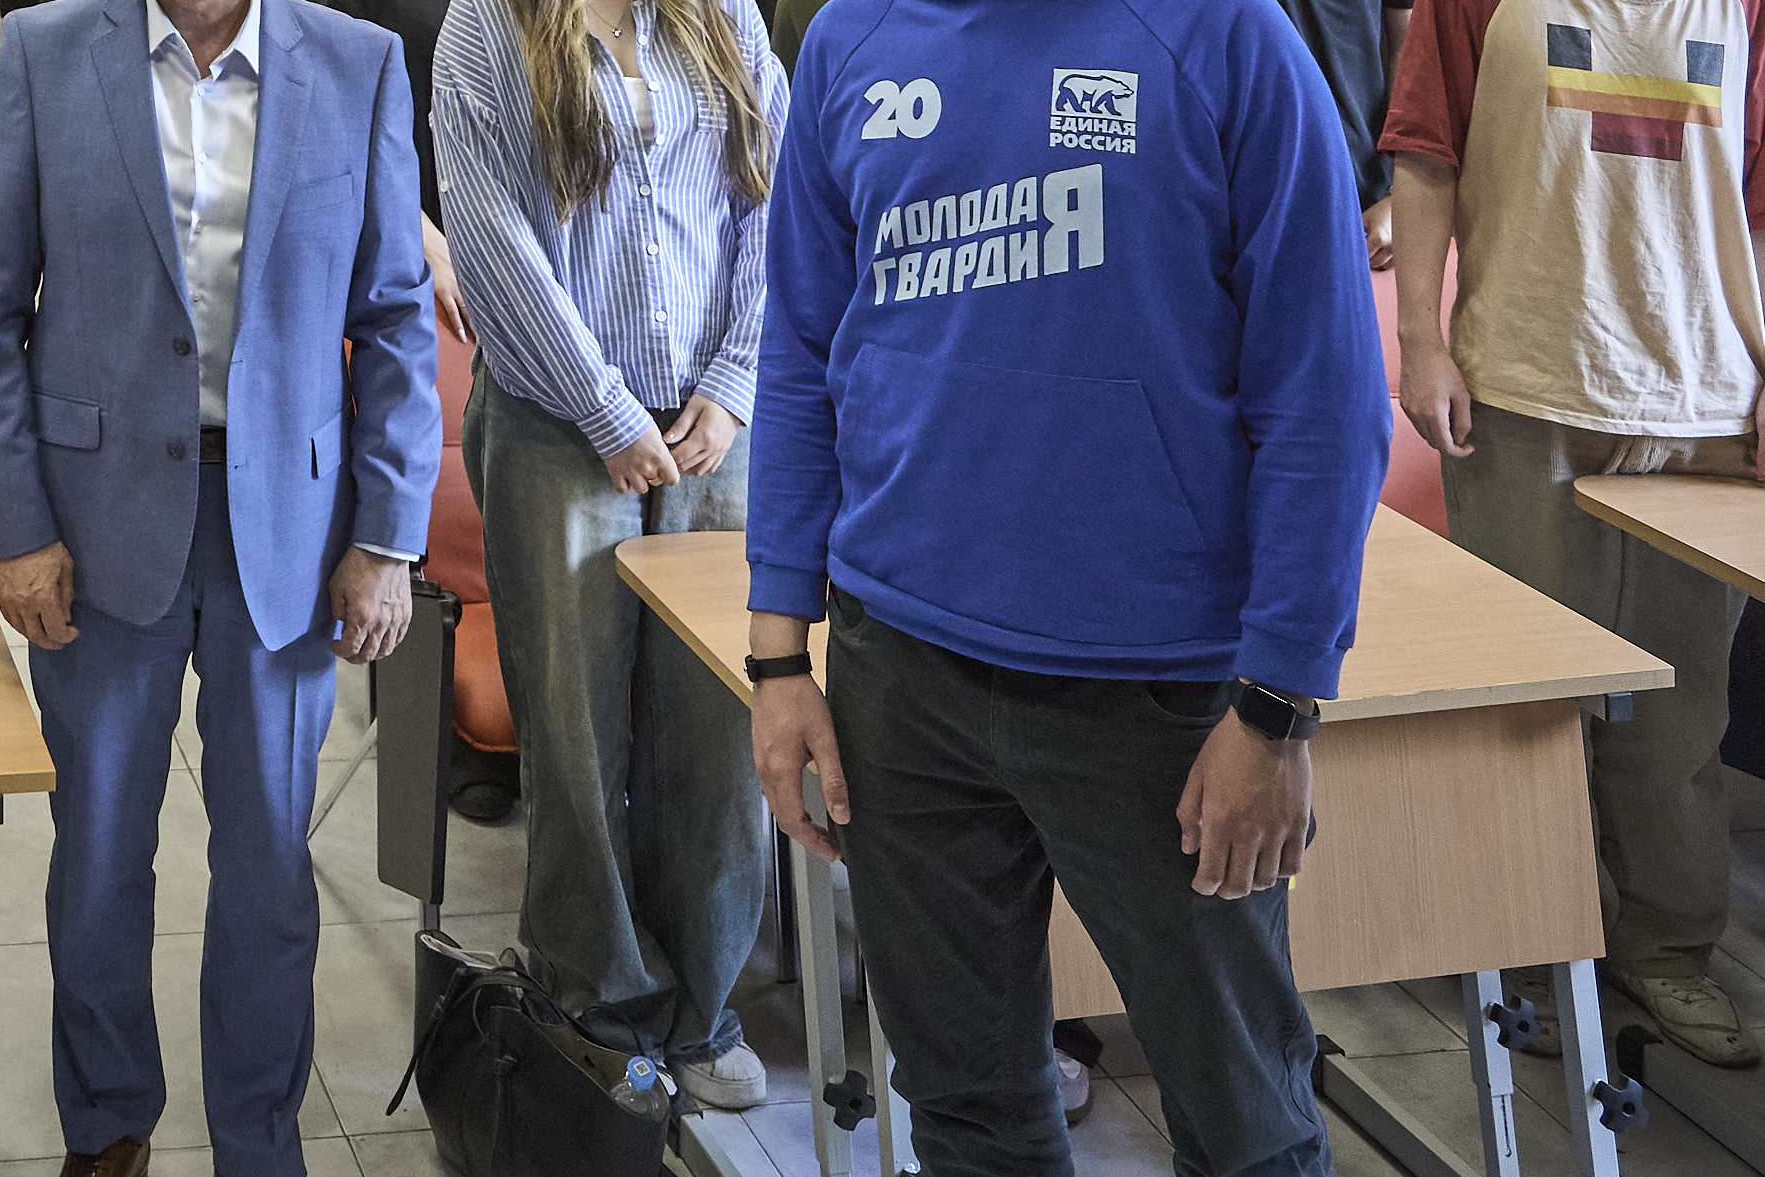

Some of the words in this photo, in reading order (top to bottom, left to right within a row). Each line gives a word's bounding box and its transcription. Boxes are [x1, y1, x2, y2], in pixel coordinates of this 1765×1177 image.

[861, 78, 943, 141] 20
[1049, 116, 1136, 137] ЕДИНАЯ
[1049, 132, 1136, 154] РОССИЯ
